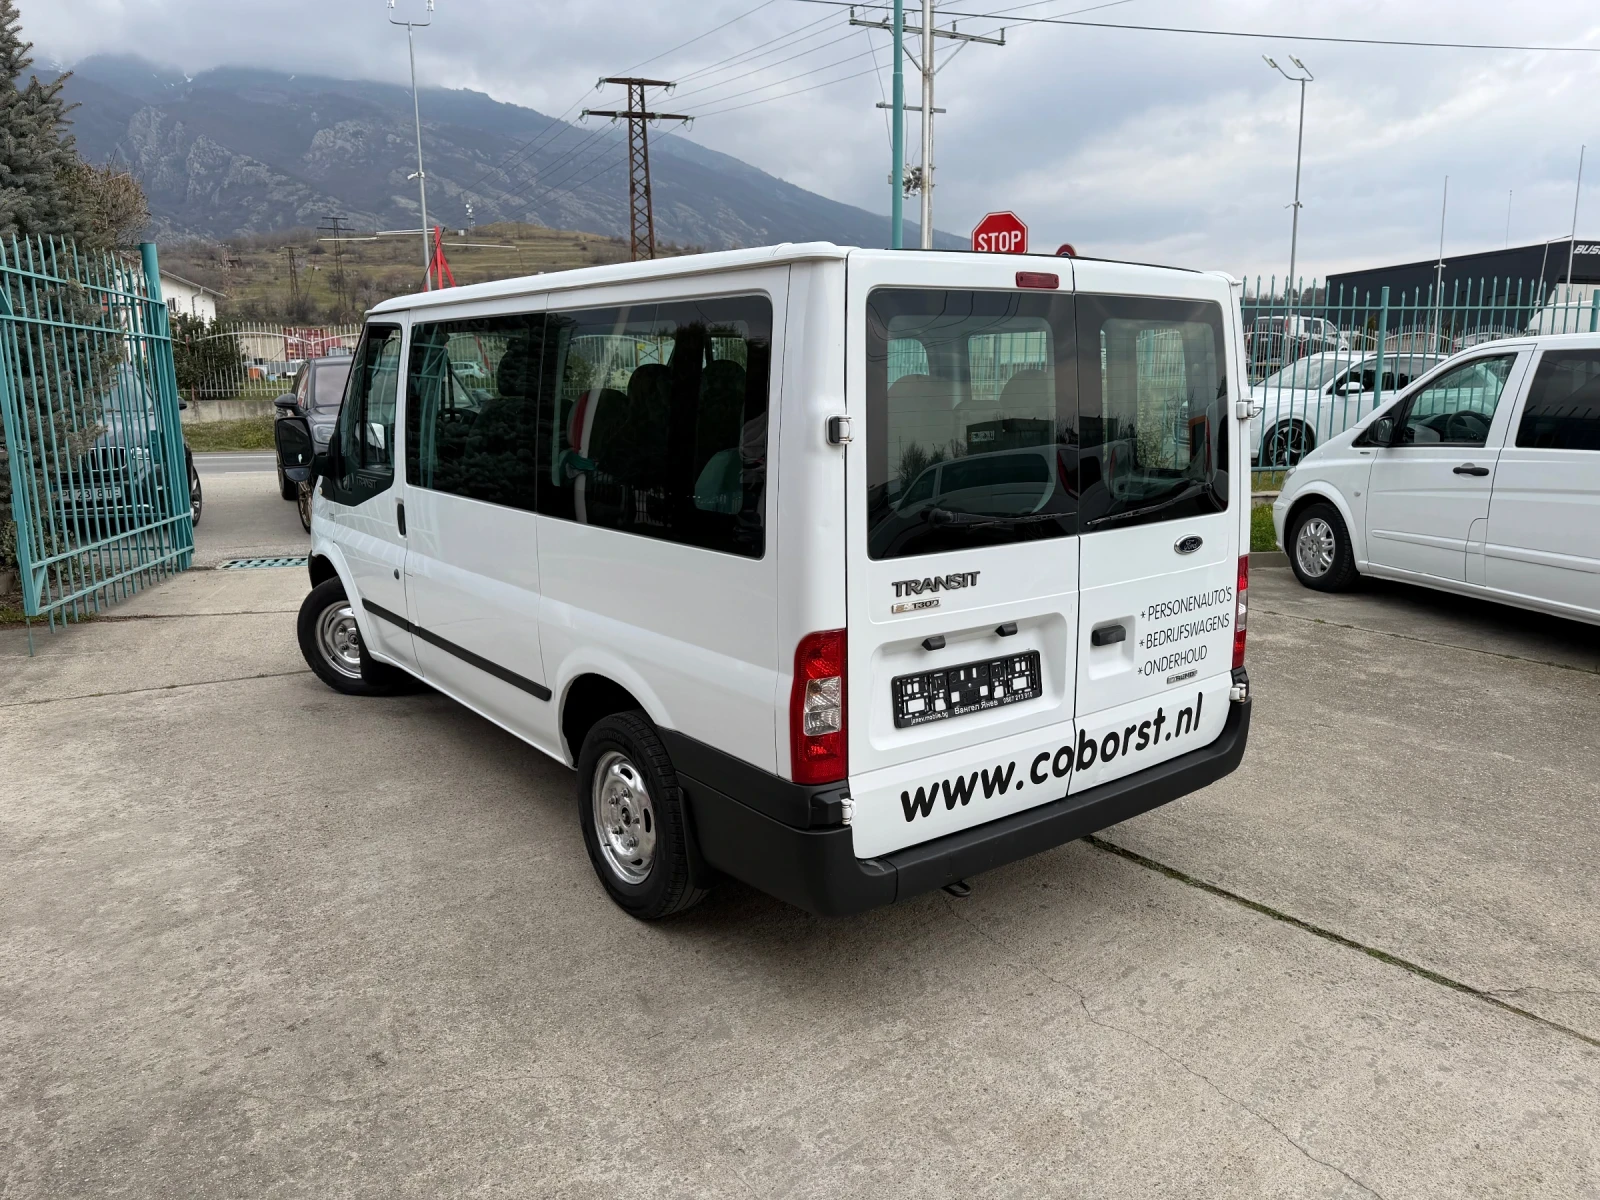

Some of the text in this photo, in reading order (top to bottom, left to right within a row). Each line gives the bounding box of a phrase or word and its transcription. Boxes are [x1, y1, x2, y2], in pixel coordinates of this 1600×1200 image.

[978, 230, 1021, 252] STOP
[1573, 244, 1600, 254] BUS
[891, 571, 981, 598] TRANSIT
[1148, 586, 1232, 621] PERSONENAUTO'S
[1146, 613, 1230, 649] BEDRIJFSWAGENS
[1143, 645, 1208, 676] ONDERHOUD
[954, 704, 980, 715] Вангел
[900, 691, 1203, 823] www.coborst.nl
